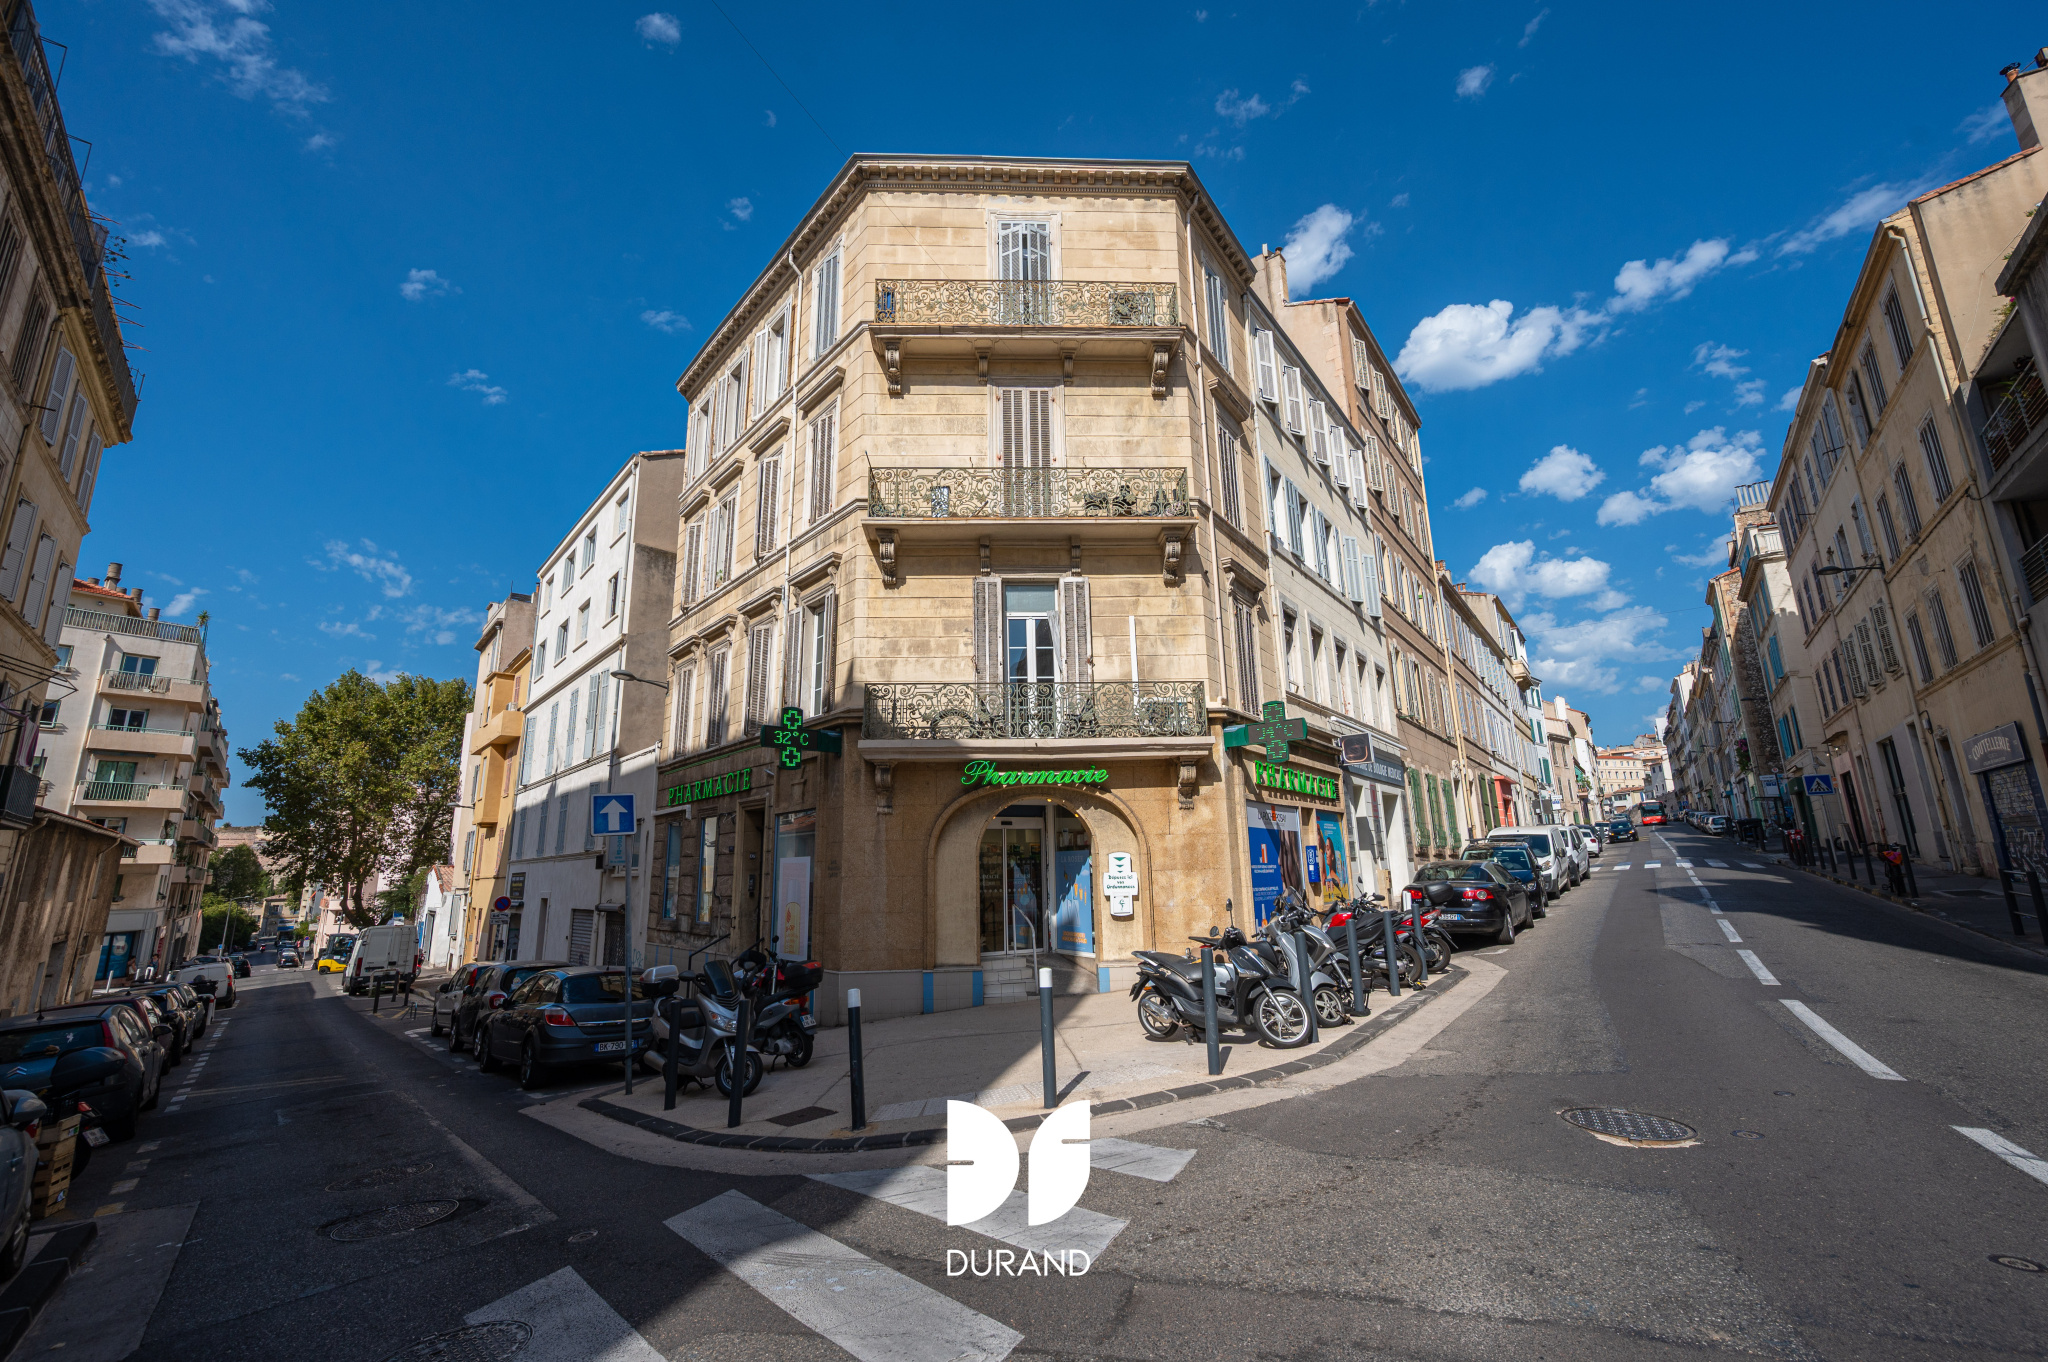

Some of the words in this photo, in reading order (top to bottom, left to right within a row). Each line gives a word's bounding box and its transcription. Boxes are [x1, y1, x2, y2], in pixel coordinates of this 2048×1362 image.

[773, 730, 809, 745] 32°C
[1972, 736, 2011, 760] COUTELLERIE
[960, 760, 1109, 785] Pharmacie
[1254, 760, 1337, 799] PHARMACIE
[667, 768, 751, 806] PHARMACIE
